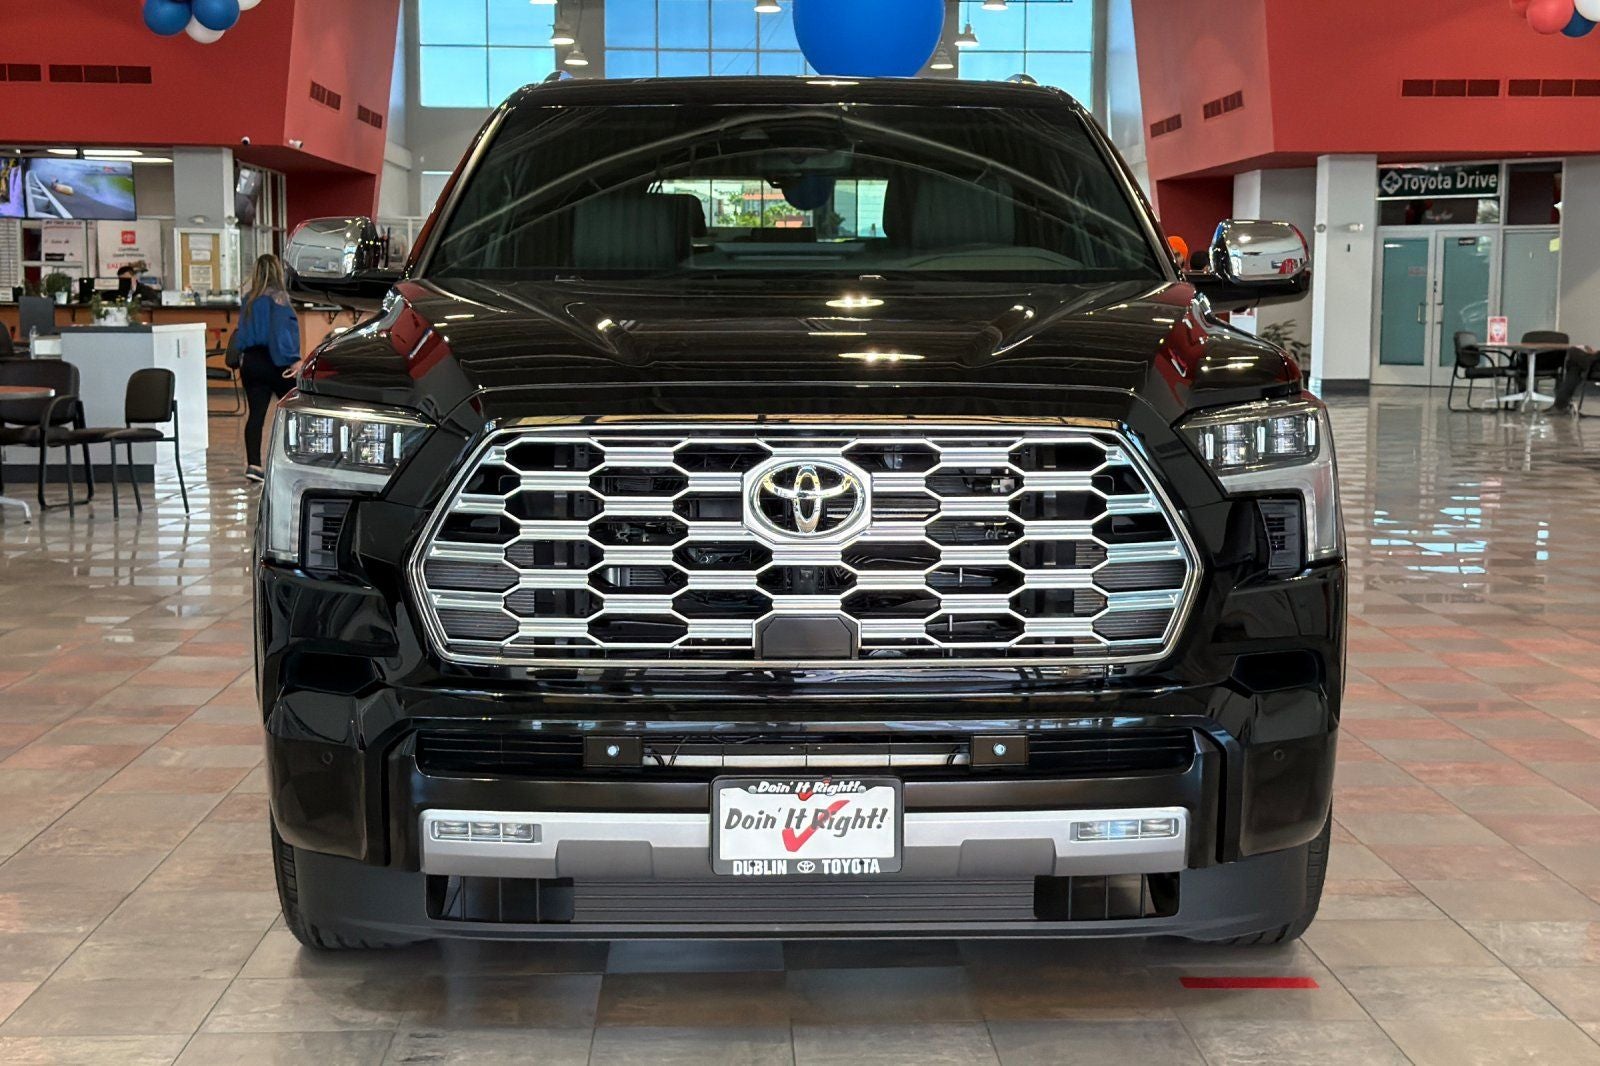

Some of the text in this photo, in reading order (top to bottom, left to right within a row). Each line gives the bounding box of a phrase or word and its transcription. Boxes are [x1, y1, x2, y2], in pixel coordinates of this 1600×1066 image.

[1402, 171, 1497, 194] Toyota Drive
[758, 781, 861, 796] Doin' It Right!
[724, 807, 889, 838] Doin' It Right!
[732, 858, 881, 875] DUBLIN TOYOTA
